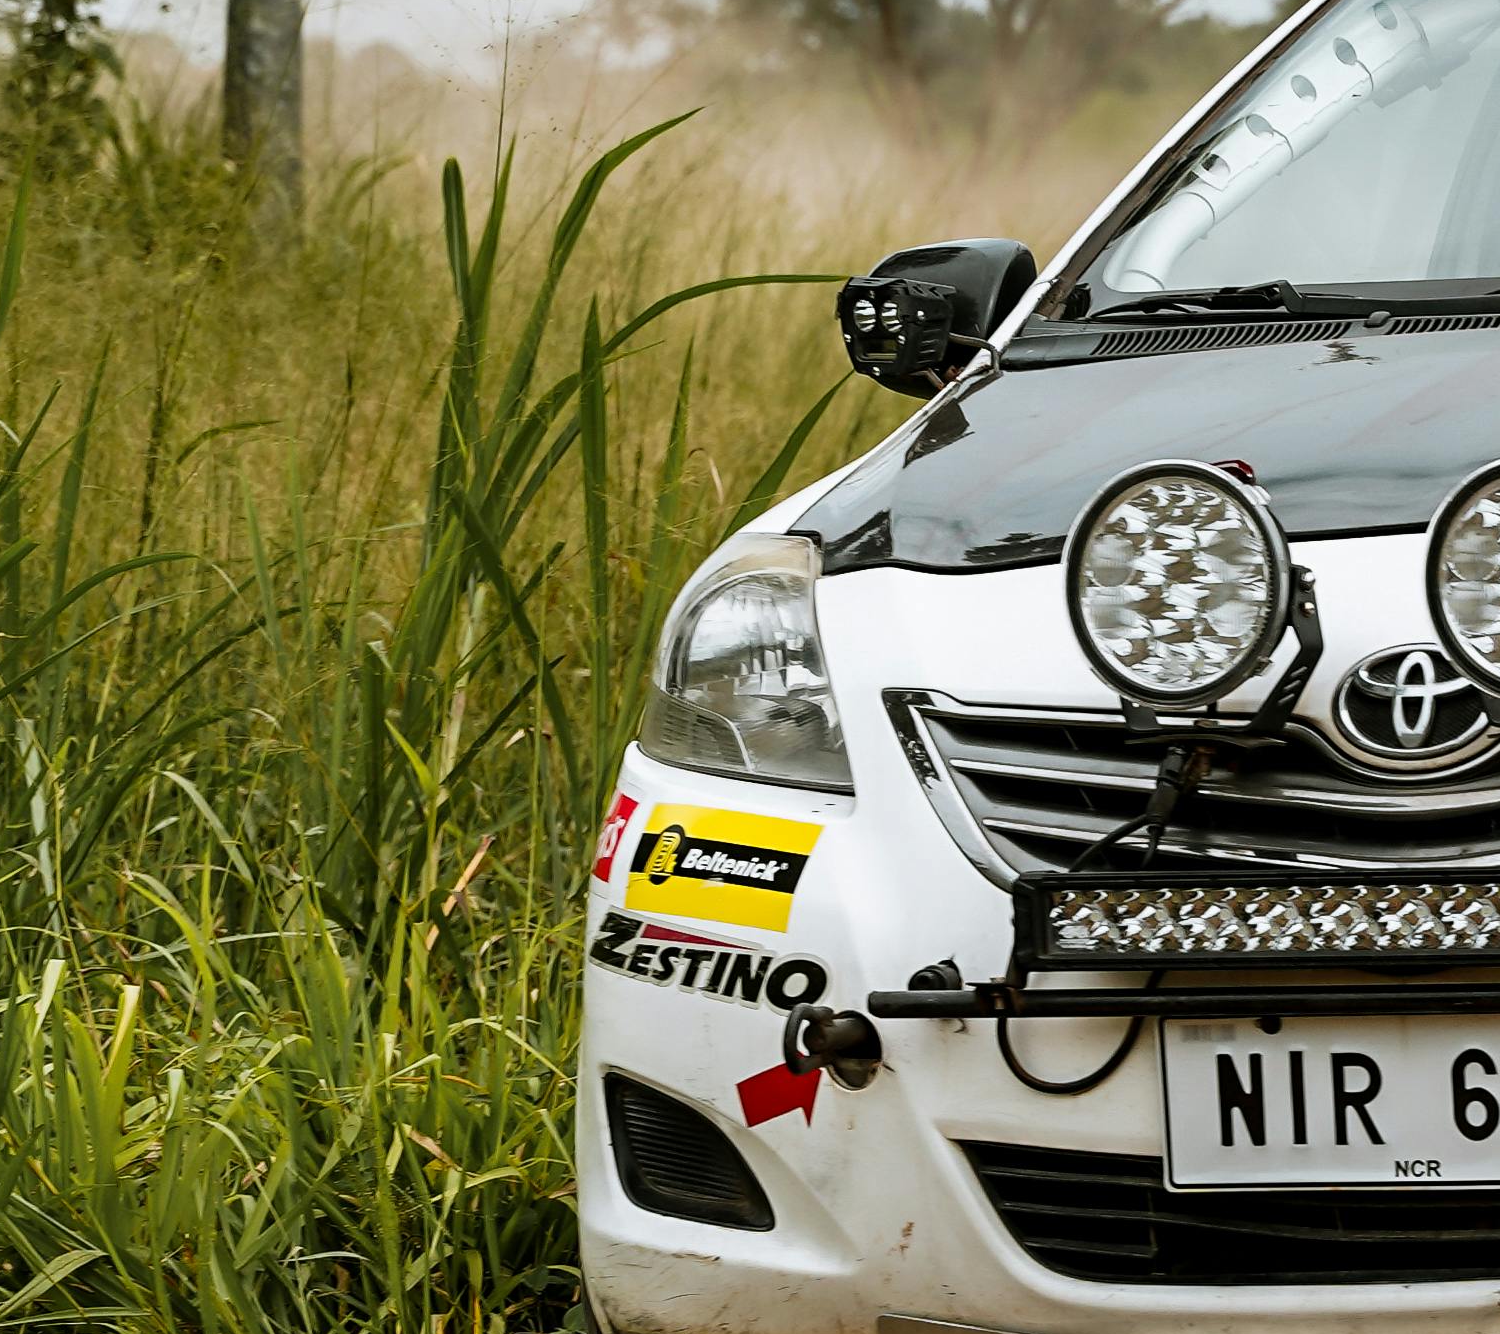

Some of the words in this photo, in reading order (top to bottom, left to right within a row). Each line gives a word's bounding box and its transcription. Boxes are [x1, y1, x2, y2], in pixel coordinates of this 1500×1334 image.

[588, 911, 828, 1012] ZESTINO
[1216, 1049, 1386, 1147] NIR
[1394, 1159, 1443, 1179] NCR
